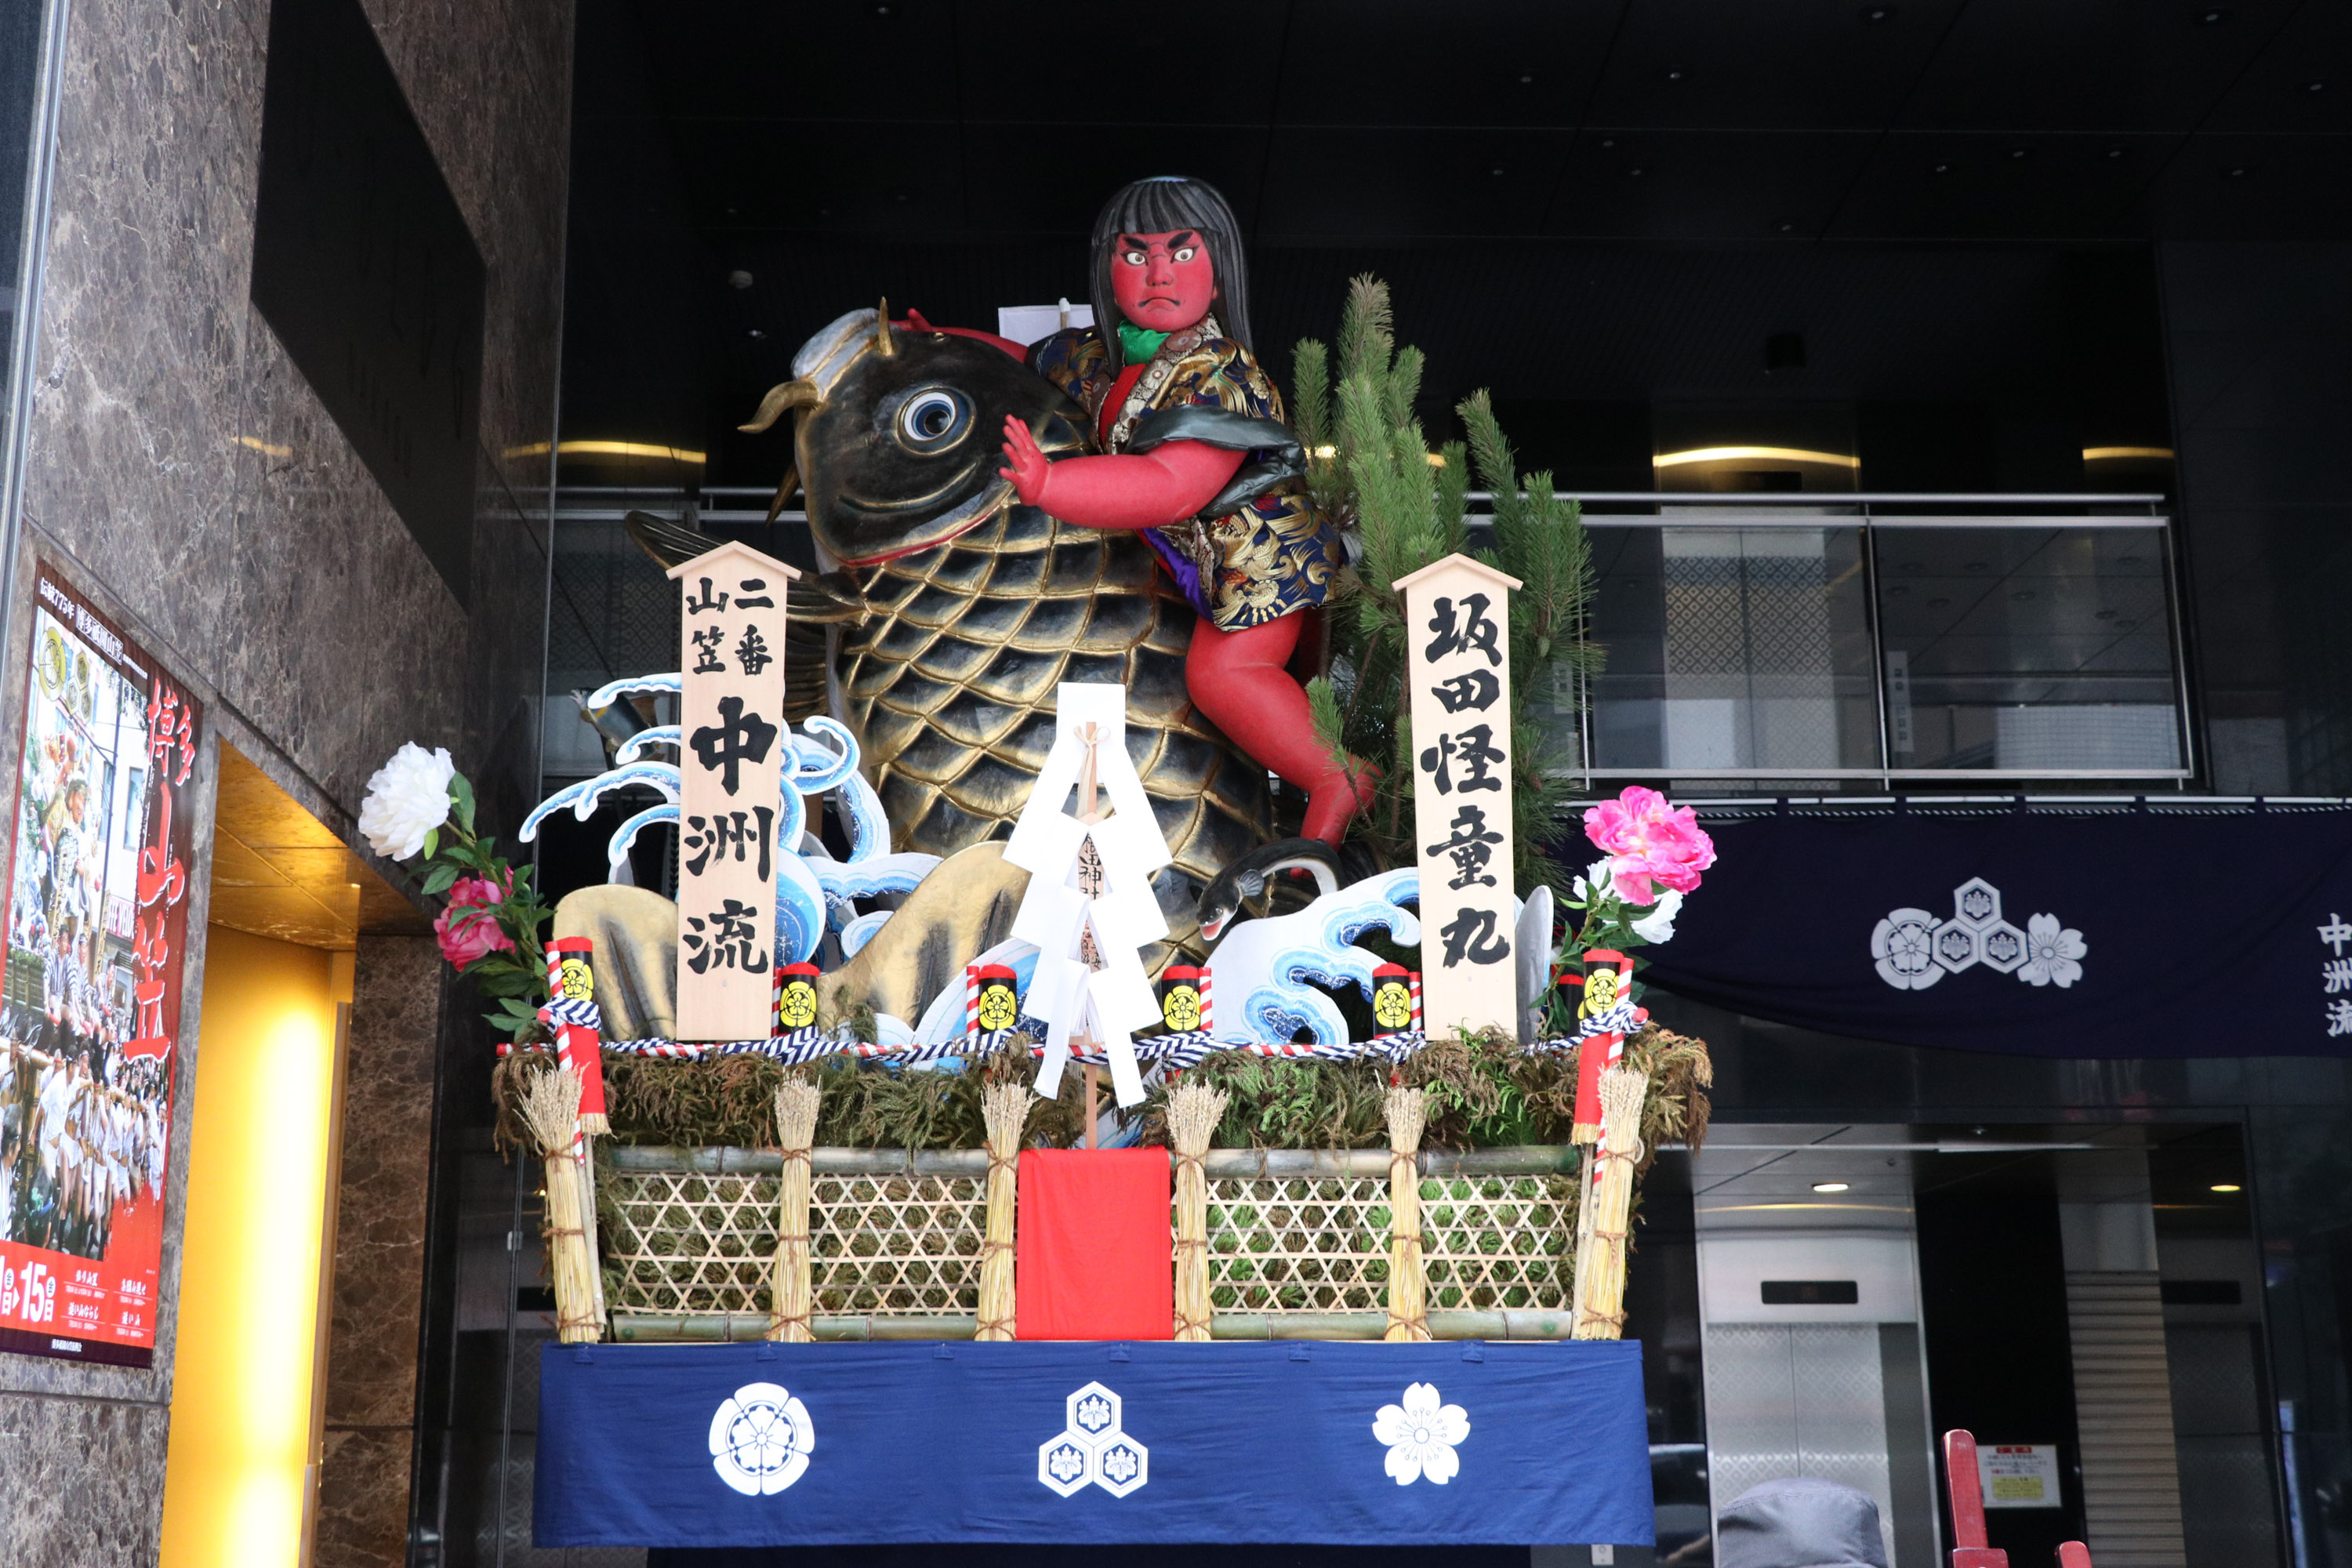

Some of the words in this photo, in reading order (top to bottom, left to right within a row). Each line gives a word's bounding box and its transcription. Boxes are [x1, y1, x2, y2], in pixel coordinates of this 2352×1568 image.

[686, 577, 729, 675] 山笠
[734, 579, 775, 677] 二番
[147, 678, 196, 786] 博多
[1420, 593, 1511, 968] 坂田怪童丸
[683, 696, 778, 975] 中洲流
